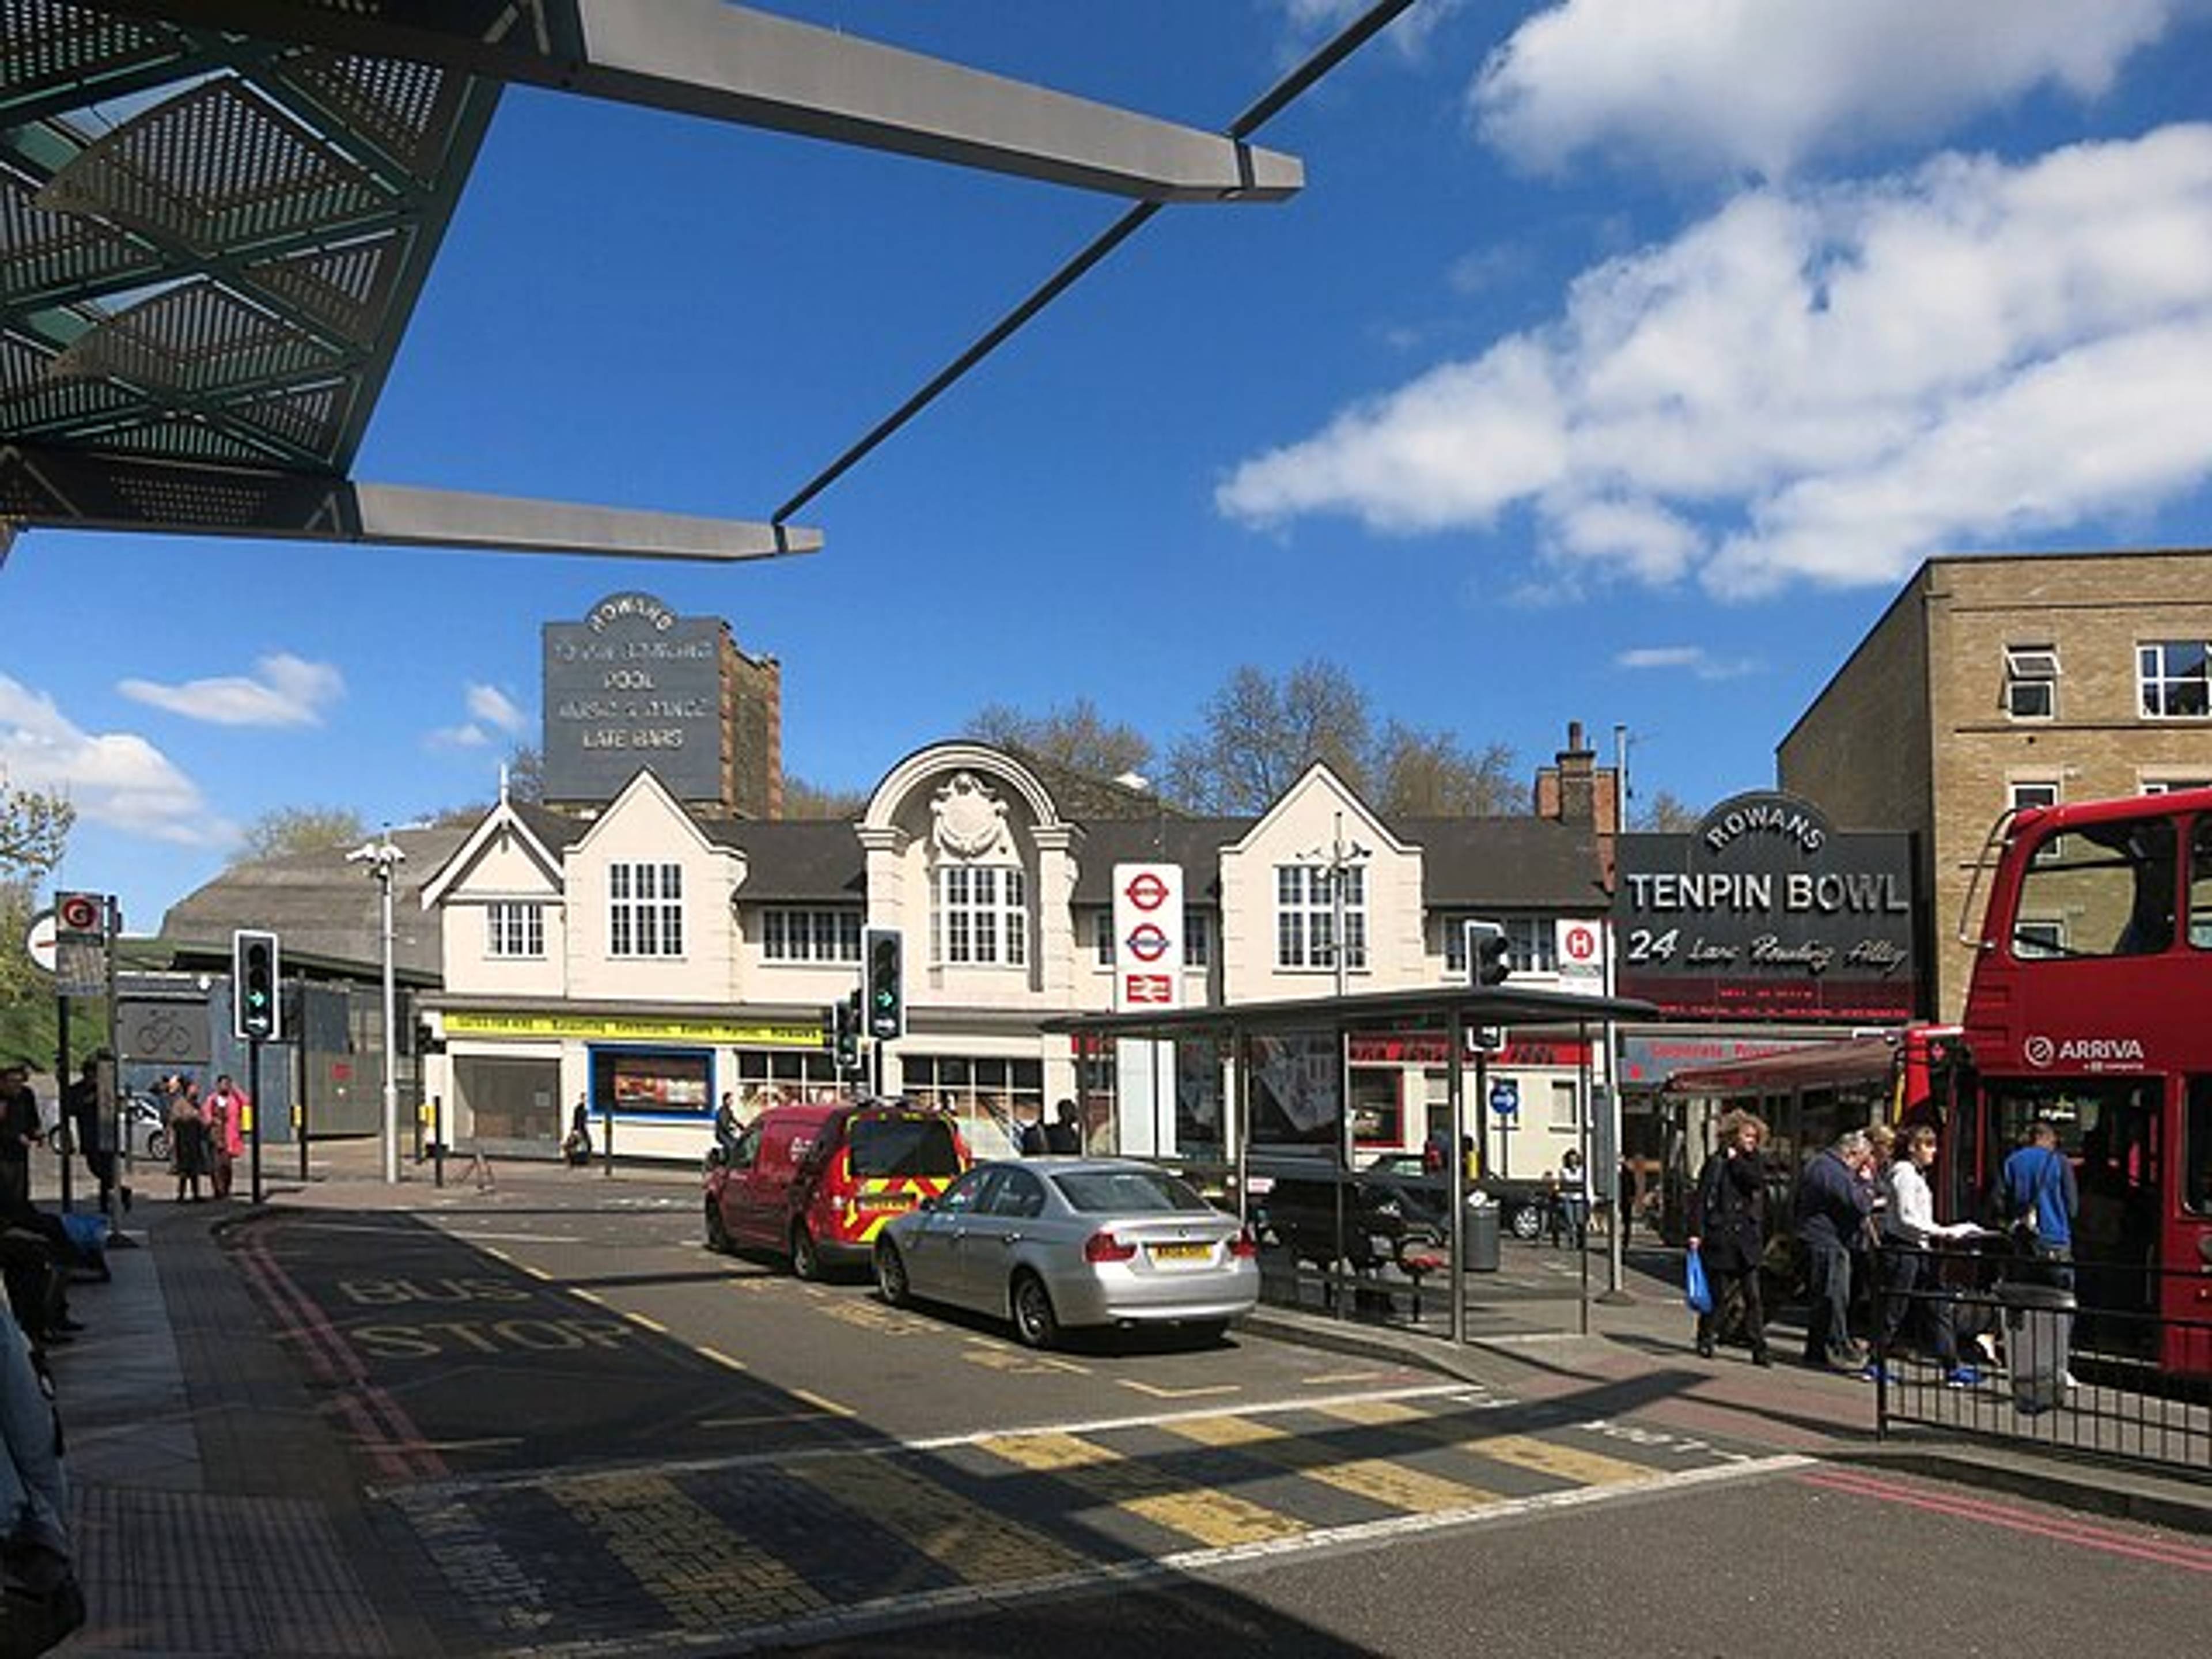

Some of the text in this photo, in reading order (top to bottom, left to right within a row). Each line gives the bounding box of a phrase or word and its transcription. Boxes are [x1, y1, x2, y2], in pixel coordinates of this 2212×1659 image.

[604, 670, 656, 689] POOL
[583, 729, 683, 747] LATE BARS
[1707, 806, 1825, 849] ROWANS
[1627, 873, 1908, 910] TENPIN BOWL
[1628, 930, 1679, 959] 24
[2059, 1040, 2144, 1059] ARRIVA
[339, 1279, 532, 1304] BUS
[351, 1320, 631, 1357] STOP
